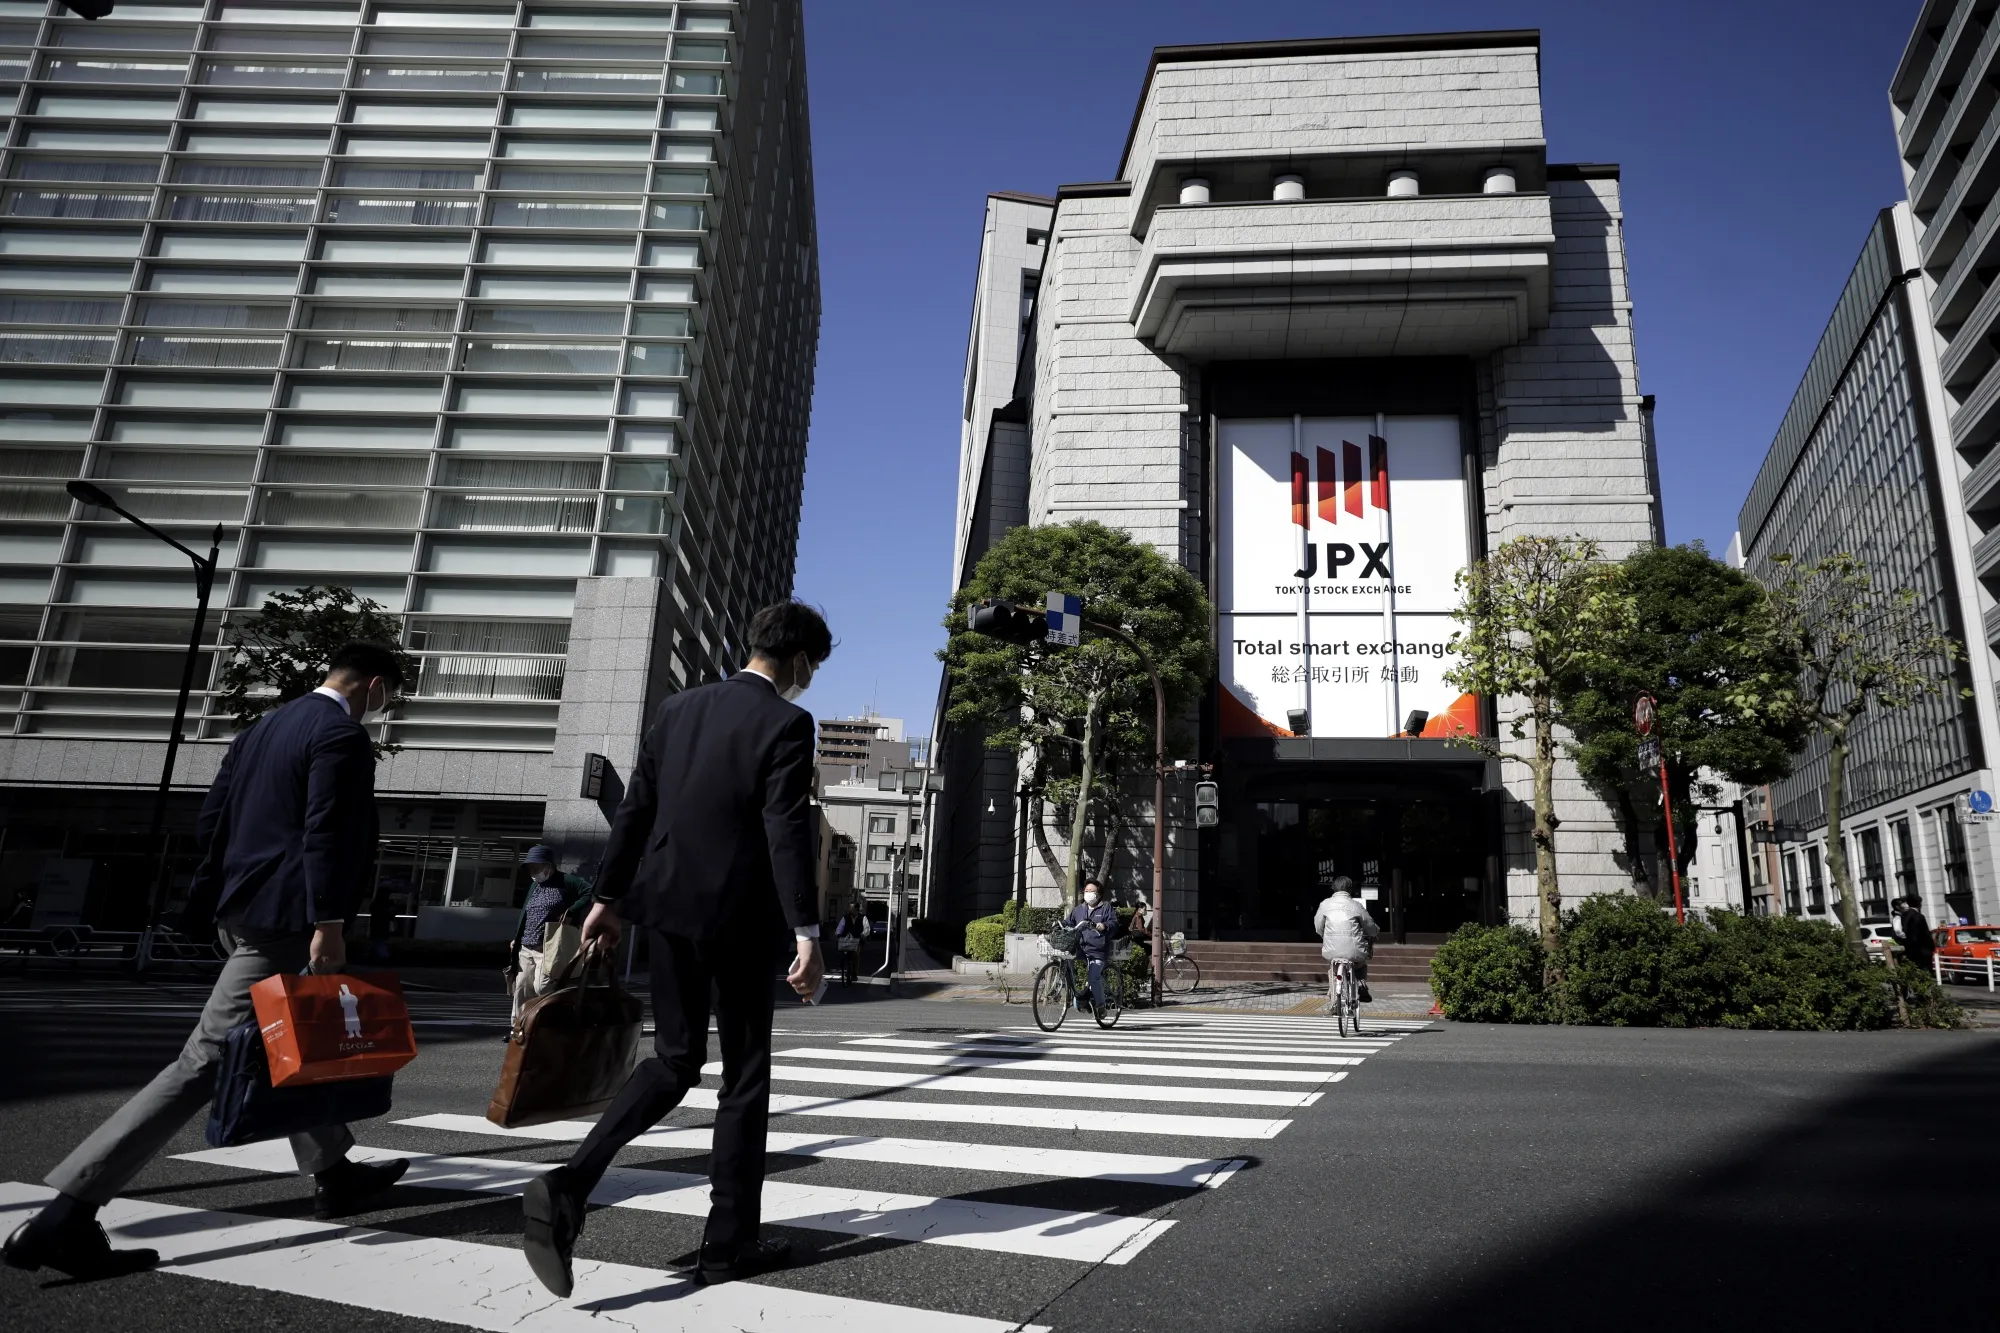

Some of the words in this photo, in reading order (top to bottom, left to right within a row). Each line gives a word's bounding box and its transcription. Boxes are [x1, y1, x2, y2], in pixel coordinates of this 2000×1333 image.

[1293, 543, 1392, 579] JPX
[1275, 585, 1311, 595] TOKYO
[1313, 586, 1349, 595] STOCK
[1352, 584, 1412, 595] EXCHANGE
[1233, 640, 1282, 655] Total
[1289, 640, 1350, 655] smart
[1271, 664, 1370, 684] 総合取引所
[1380, 664, 1419, 684] 始動
[1364, 876, 1379, 884] JPX
